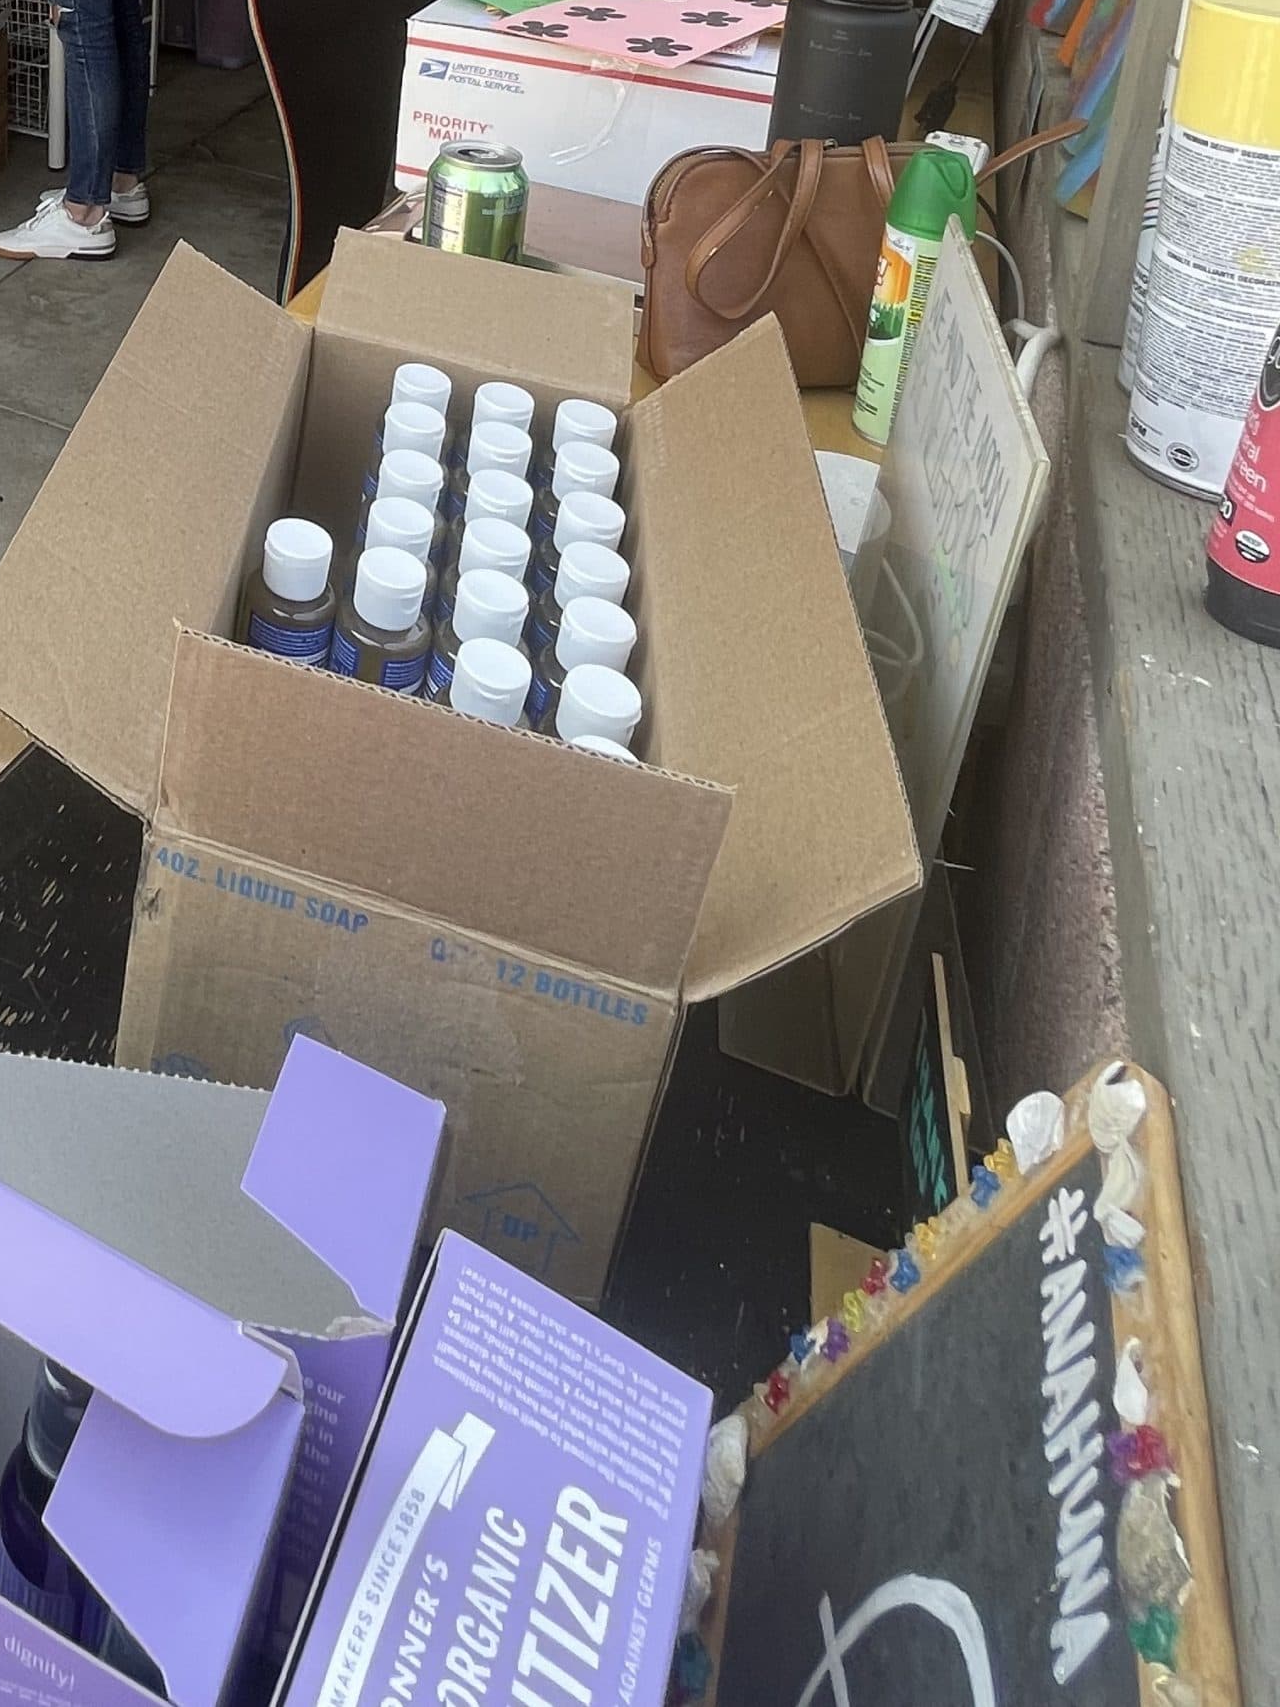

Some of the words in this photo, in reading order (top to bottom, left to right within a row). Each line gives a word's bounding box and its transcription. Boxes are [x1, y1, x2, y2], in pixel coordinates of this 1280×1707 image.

[448, 74, 483, 88] POSTAL
[451, 62, 487, 76] UNITED
[487, 69, 520, 82] STATES
[970, 413, 1010, 537] MOON
[215, 867, 297, 910] LIQUID
[305, 897, 368, 934] SOAP
[496, 958, 526, 987] 12
[534, 971, 648, 1025] BOTTLES
[504, 1212, 540, 1244] UP
[446, 1306, 461, 1326] Be
[317, 1382, 346, 1405] our
[365, 1539, 401, 1607] SINCE
[394, 1487, 426, 1542] 1858
[436, 1506, 528, 1707] ORGANIC
[620, 1602, 649, 1704] AGAINST
[636, 1536, 663, 1610] GERMS
[4, 1635, 75, 1692] dignity!
